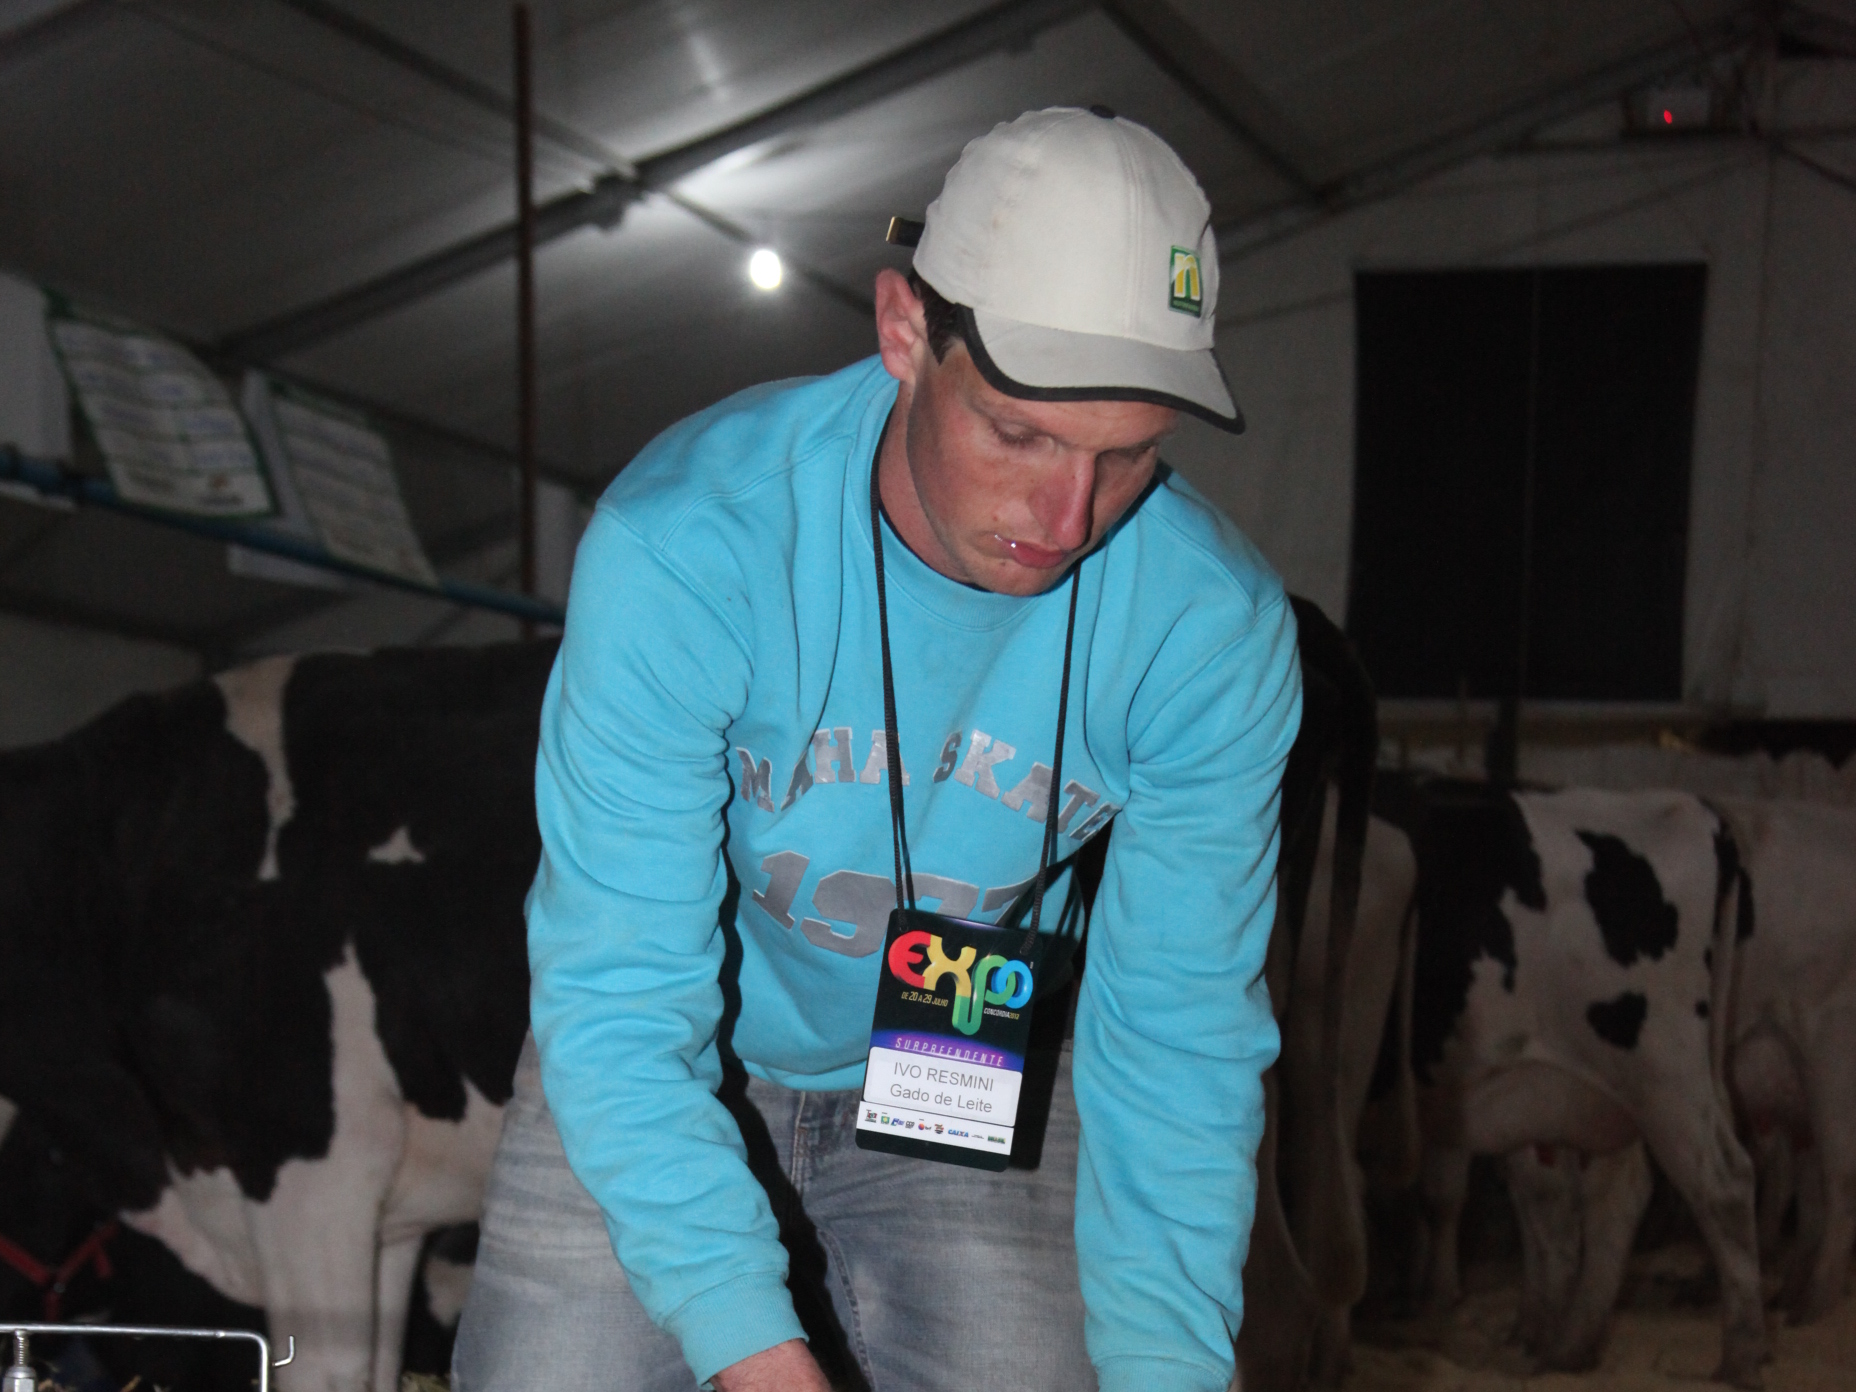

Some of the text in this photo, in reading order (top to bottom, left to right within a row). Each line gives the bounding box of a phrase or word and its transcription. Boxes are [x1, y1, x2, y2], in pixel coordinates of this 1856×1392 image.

[908, 990, 918, 1002] 20
[922, 993, 932, 1004] 29
[931, 997, 949, 1008] JULHO
[895, 1037, 1004, 1067] SURPREENDENTE
[893, 1061, 994, 1092] IVO RESMINI
[890, 1083, 993, 1113] Gado de Leite
[947, 1129, 969, 1138] CAIXA
